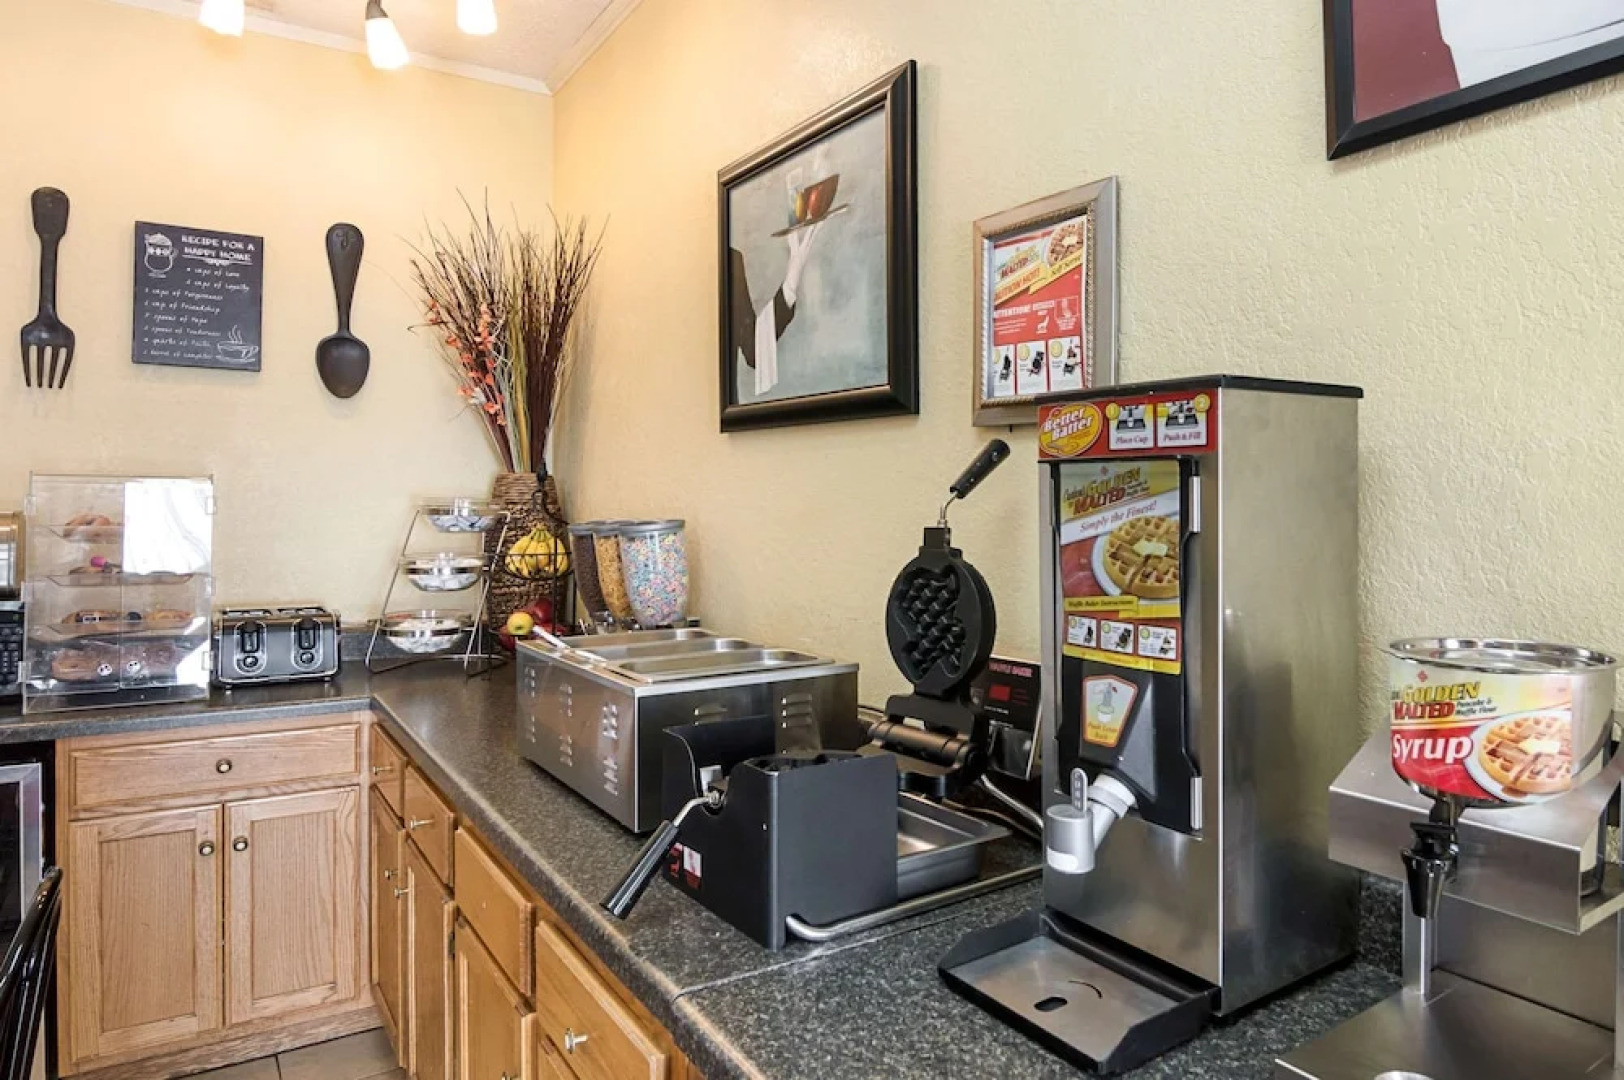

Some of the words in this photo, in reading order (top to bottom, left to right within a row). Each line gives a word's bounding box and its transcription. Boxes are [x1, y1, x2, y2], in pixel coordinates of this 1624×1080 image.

[182, 235, 220, 247] RECIPE
[221, 240, 244, 250] FOR
[247, 243, 255, 251] A
[184, 246, 216, 257] HAPPY
[220, 250, 251, 261] HOME
[1044, 408, 1085, 432] Better
[1134, 434, 1149, 445] Cup
[1074, 486, 1126, 515] MALTED
[1080, 515, 1110, 533] Simply
[1111, 511, 1125, 522] the
[1125, 500, 1157, 519] Finest!
[1402, 681, 1481, 703] GOLDEN
[1393, 734, 1472, 763] Syrup
